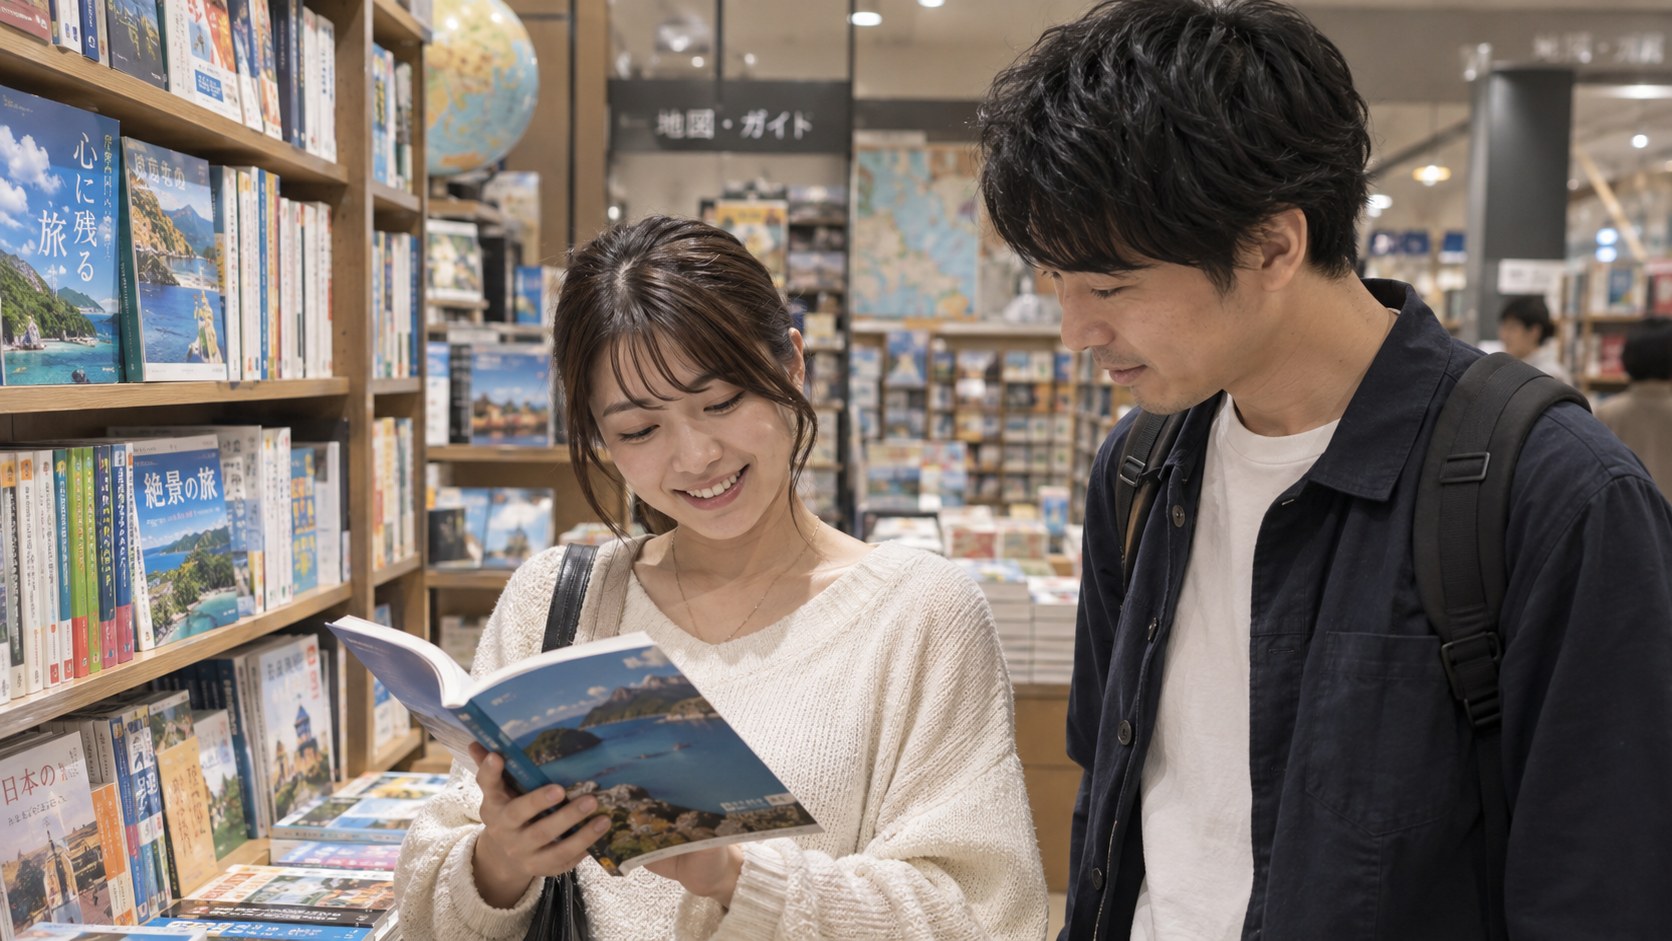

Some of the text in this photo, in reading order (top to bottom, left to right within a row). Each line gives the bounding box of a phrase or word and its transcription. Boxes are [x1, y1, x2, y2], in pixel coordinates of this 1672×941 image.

[655, 108, 814, 140] 地図・ガイド
[73, 131, 98, 282] 心に残る
[37, 200, 68, 258] 旅
[143, 466, 219, 509] 絶景の旅
[2, 764, 56, 806] 日本の
